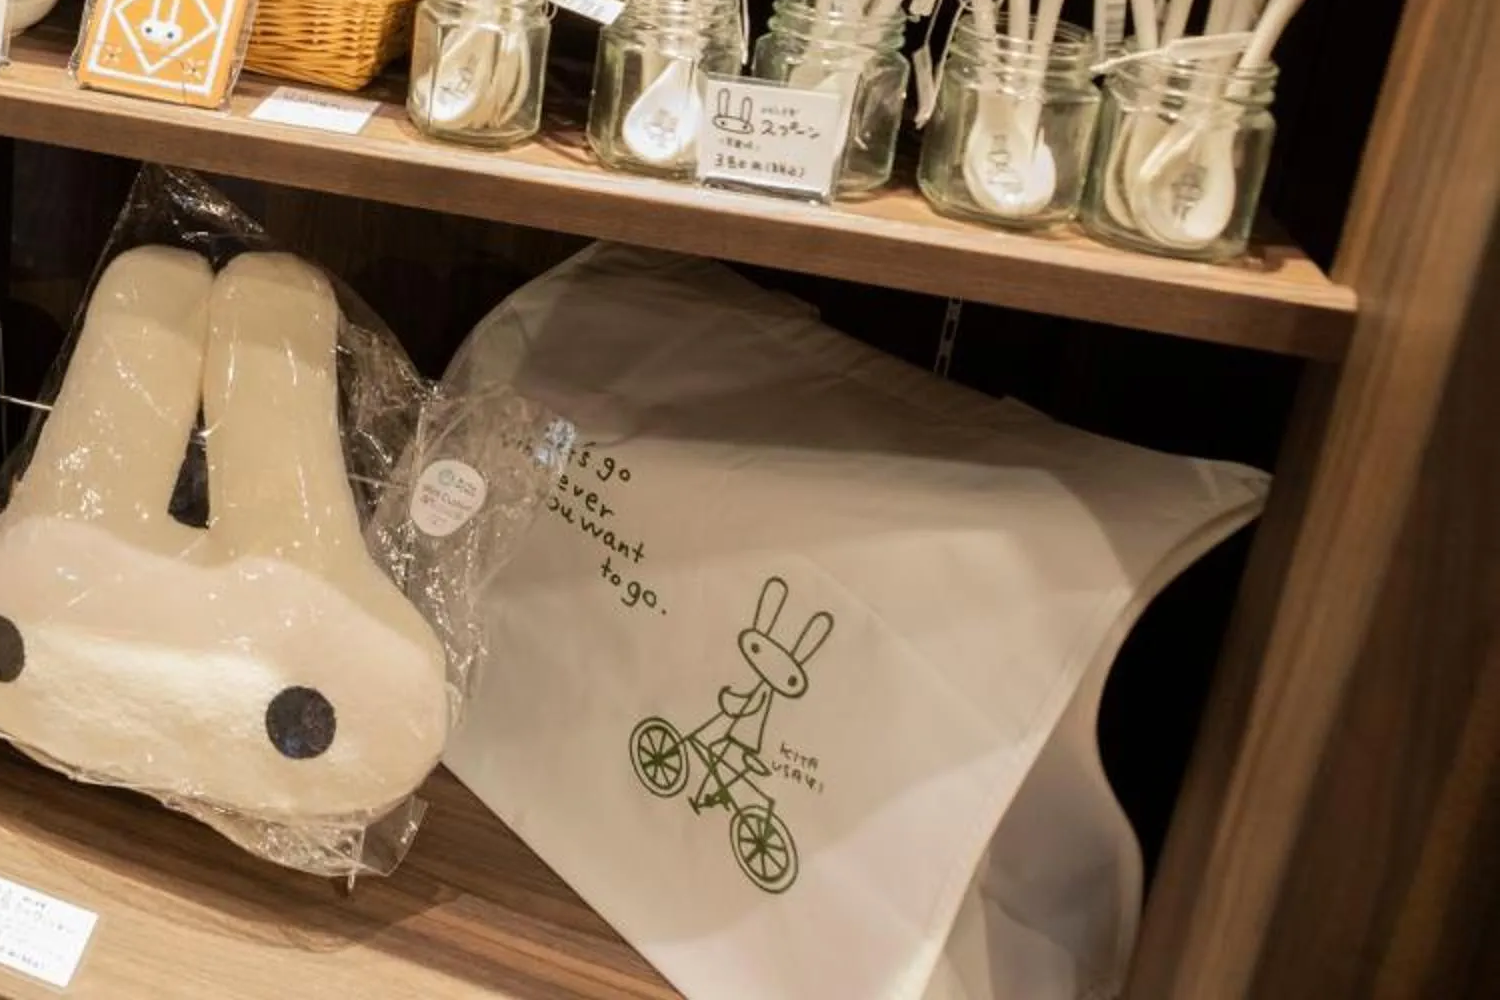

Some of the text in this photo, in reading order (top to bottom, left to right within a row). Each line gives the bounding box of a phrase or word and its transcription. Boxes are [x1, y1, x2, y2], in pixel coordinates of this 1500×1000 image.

[761, 119, 820, 139] スプーン
[596, 456, 632, 484] go
[545, 495, 647, 564] ou want
[600, 558, 669, 617] to go.
